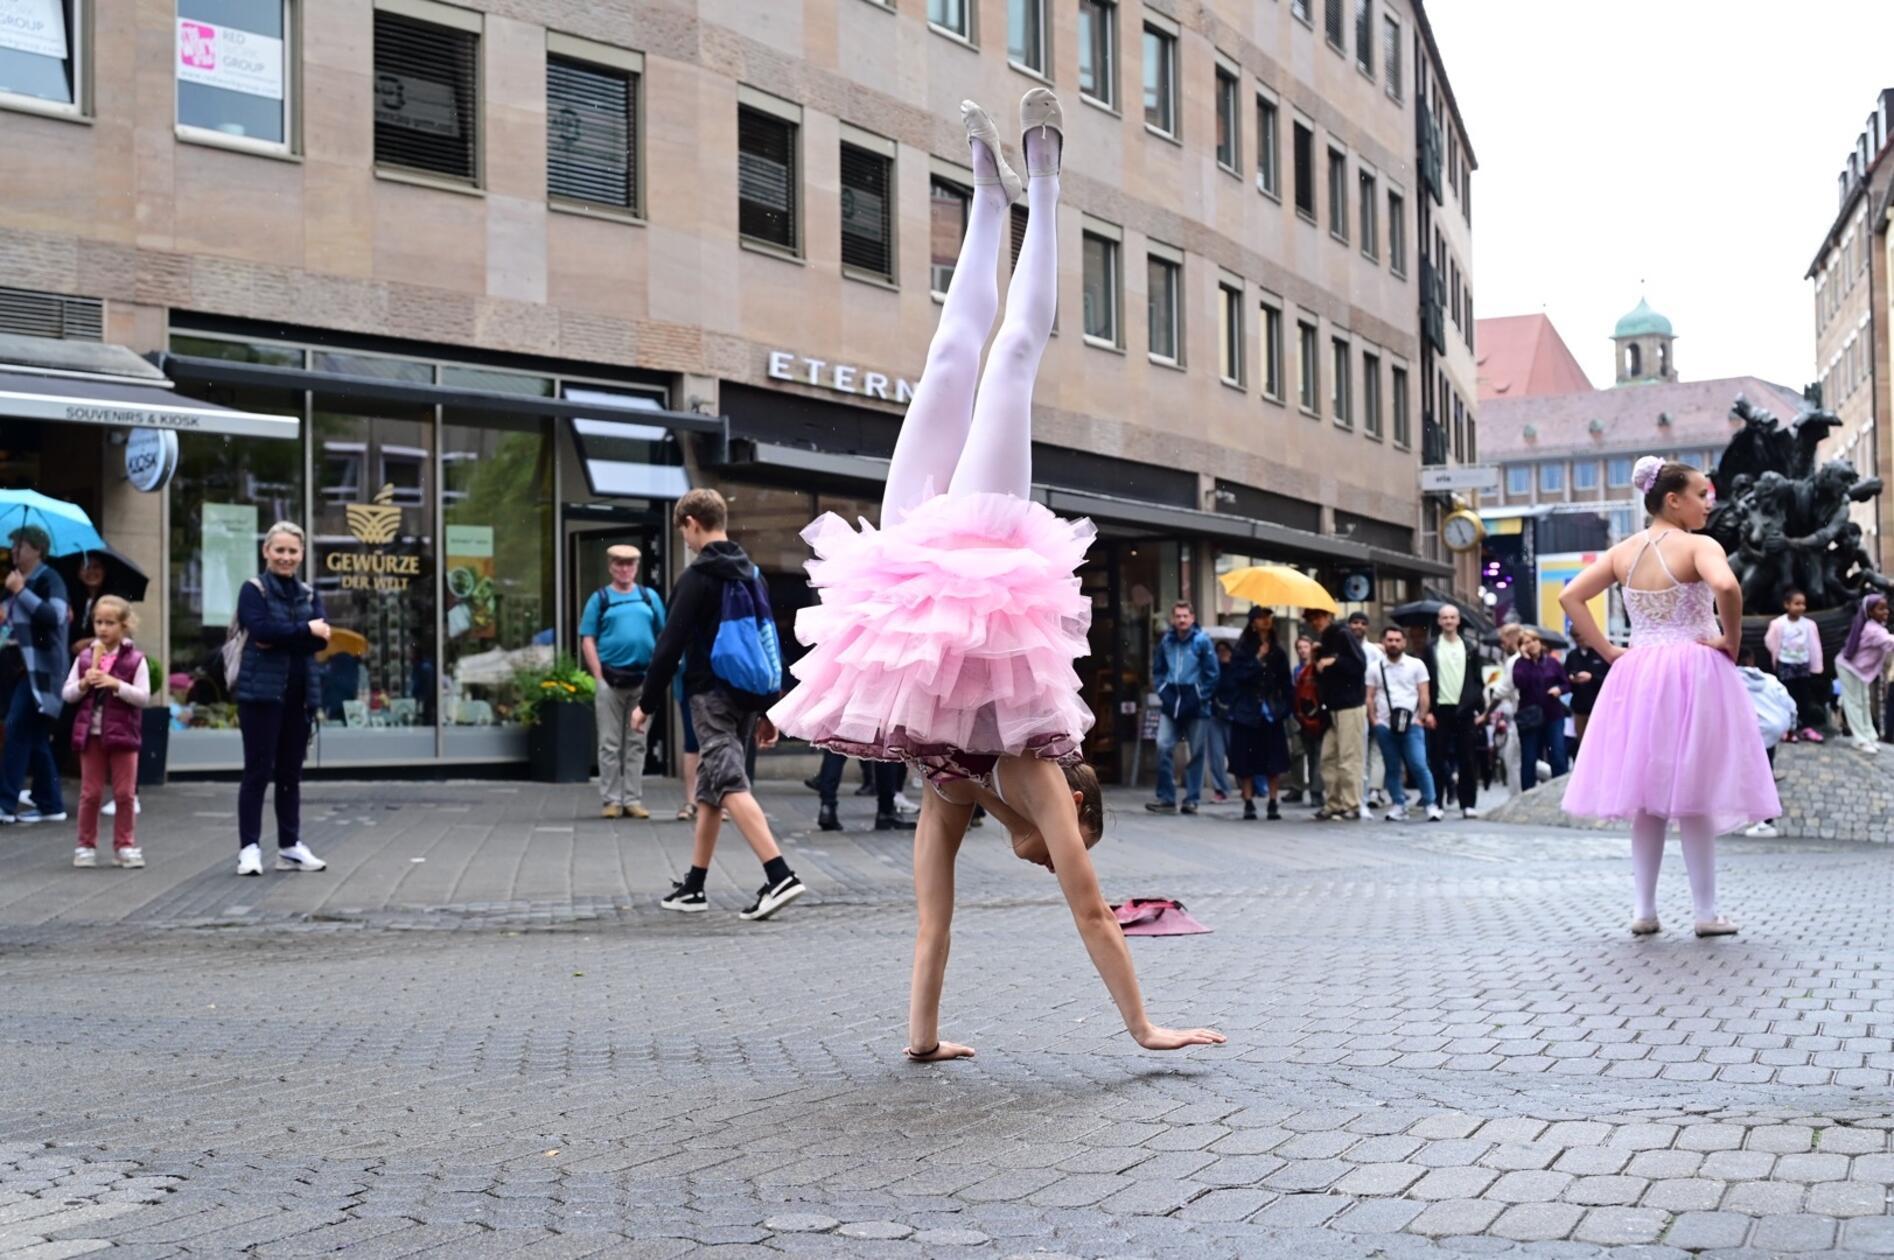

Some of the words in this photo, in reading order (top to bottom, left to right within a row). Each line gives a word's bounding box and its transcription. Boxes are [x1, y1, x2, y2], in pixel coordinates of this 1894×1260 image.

[222, 28, 246, 46] RED
[222, 54, 265, 73] GROUP
[66, 406, 144, 422] SOUVENIRS
[147, 413, 156, 423] &
[159, 413, 200, 427] KIOSK
[326, 549, 421, 575] GEWÜRZE
[341, 575, 370, 591] DER
[373, 577, 410, 592] WELT
